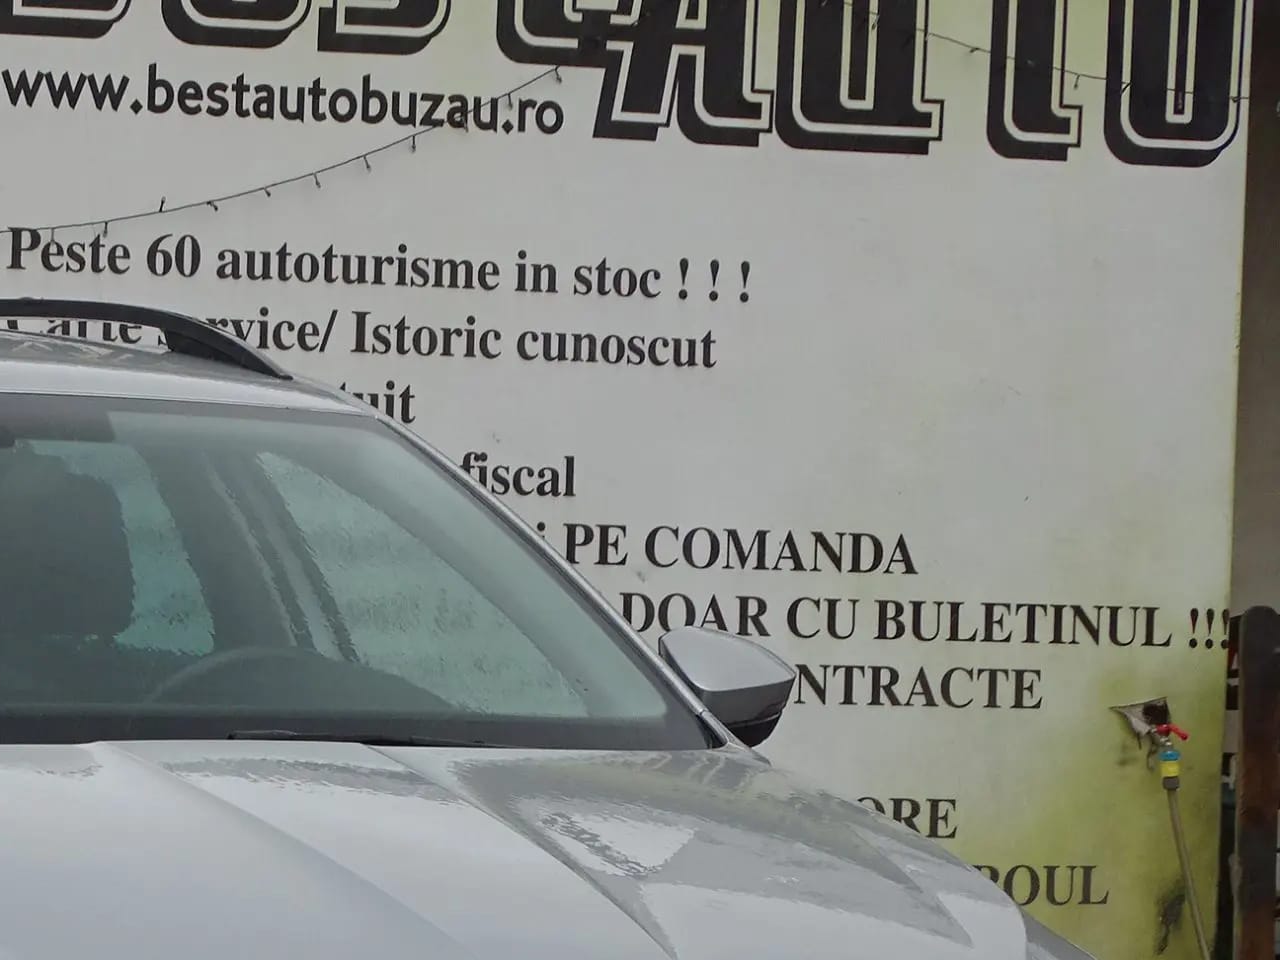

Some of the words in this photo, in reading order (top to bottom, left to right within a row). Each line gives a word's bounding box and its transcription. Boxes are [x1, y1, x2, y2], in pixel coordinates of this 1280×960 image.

[2, 63, 564, 136] www.bestautobuzau.ro
[7, 227, 131, 275] Peste
[146, 234, 201, 278] 60
[216, 242, 500, 291] autoturisme
[514, 250, 558, 294] in
[573, 257, 662, 299] stoc
[350, 310, 502, 360] Istoric
[516, 323, 718, 369] cunoscut
[563, 522, 629, 567] PE
[644, 525, 919, 575] COMANDA
[620, 592, 772, 638] DOAR
[786, 596, 862, 640] CU
[873, 599, 1173, 648] BULETINUL
